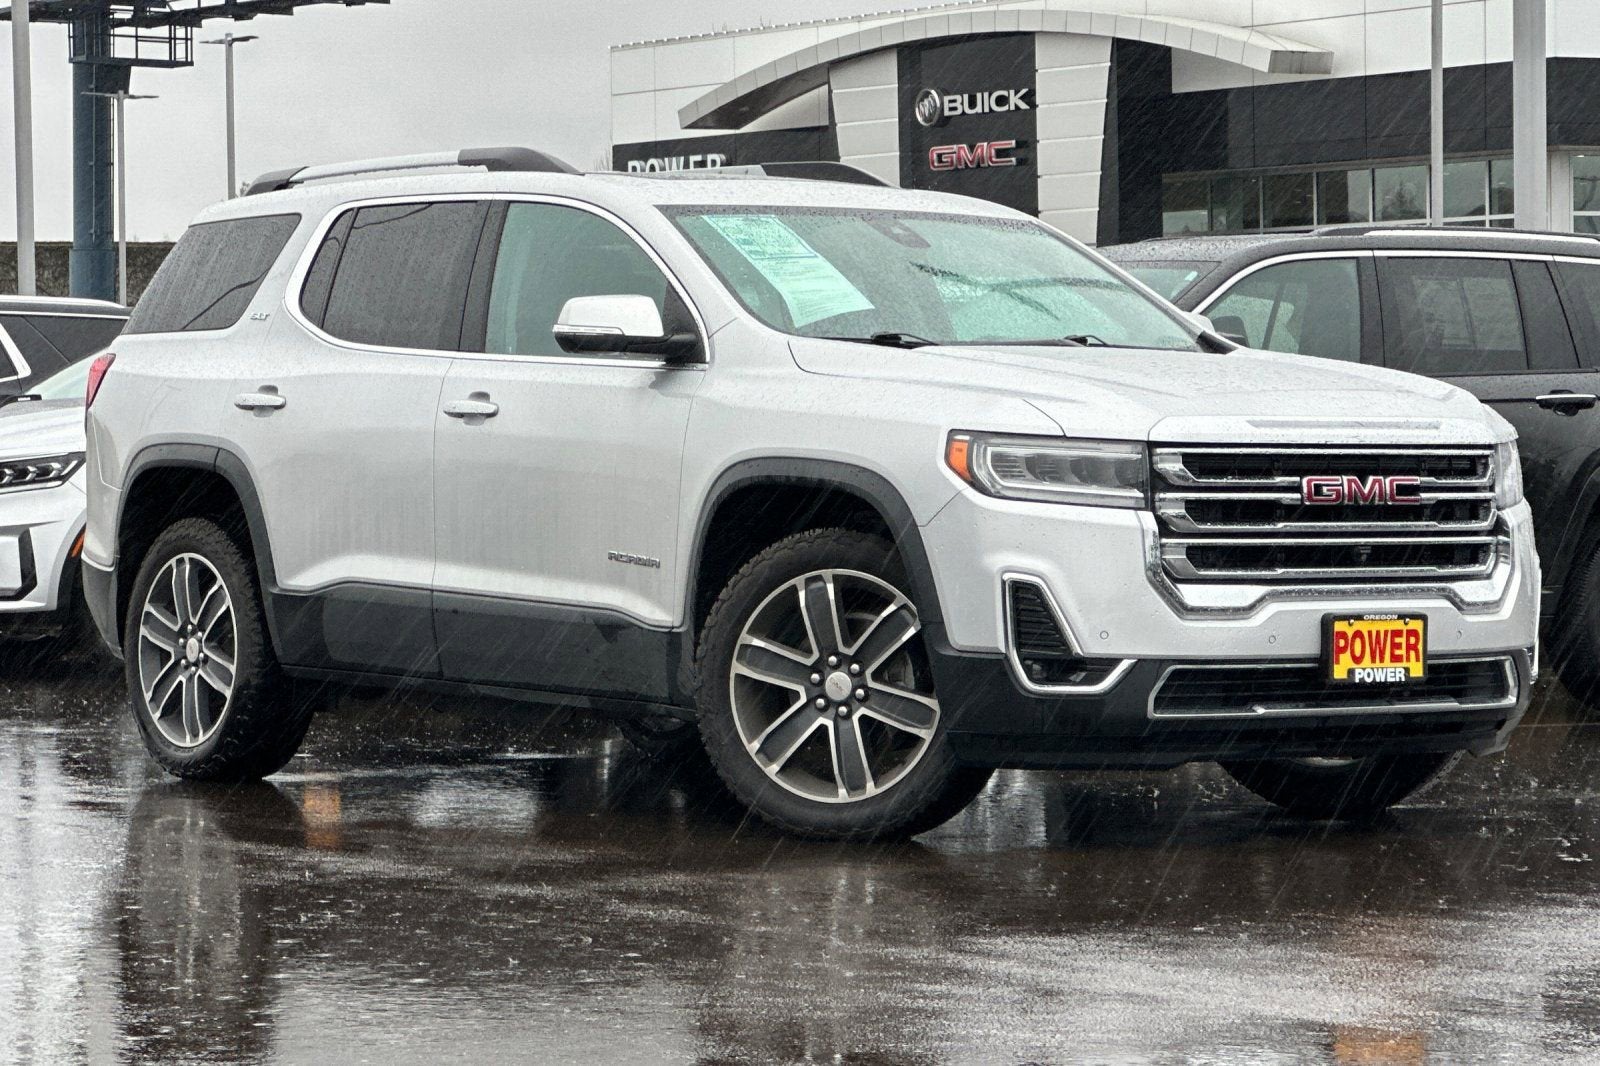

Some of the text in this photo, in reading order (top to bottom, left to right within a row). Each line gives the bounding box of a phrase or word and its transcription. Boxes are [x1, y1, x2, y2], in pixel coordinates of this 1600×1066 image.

[943, 88, 1030, 116] BUICK
[928, 140, 1017, 171] GMC
[1302, 475, 1421, 505] GMC
[1334, 628, 1421, 666] POWER
[1354, 667, 1406, 683] POWER
